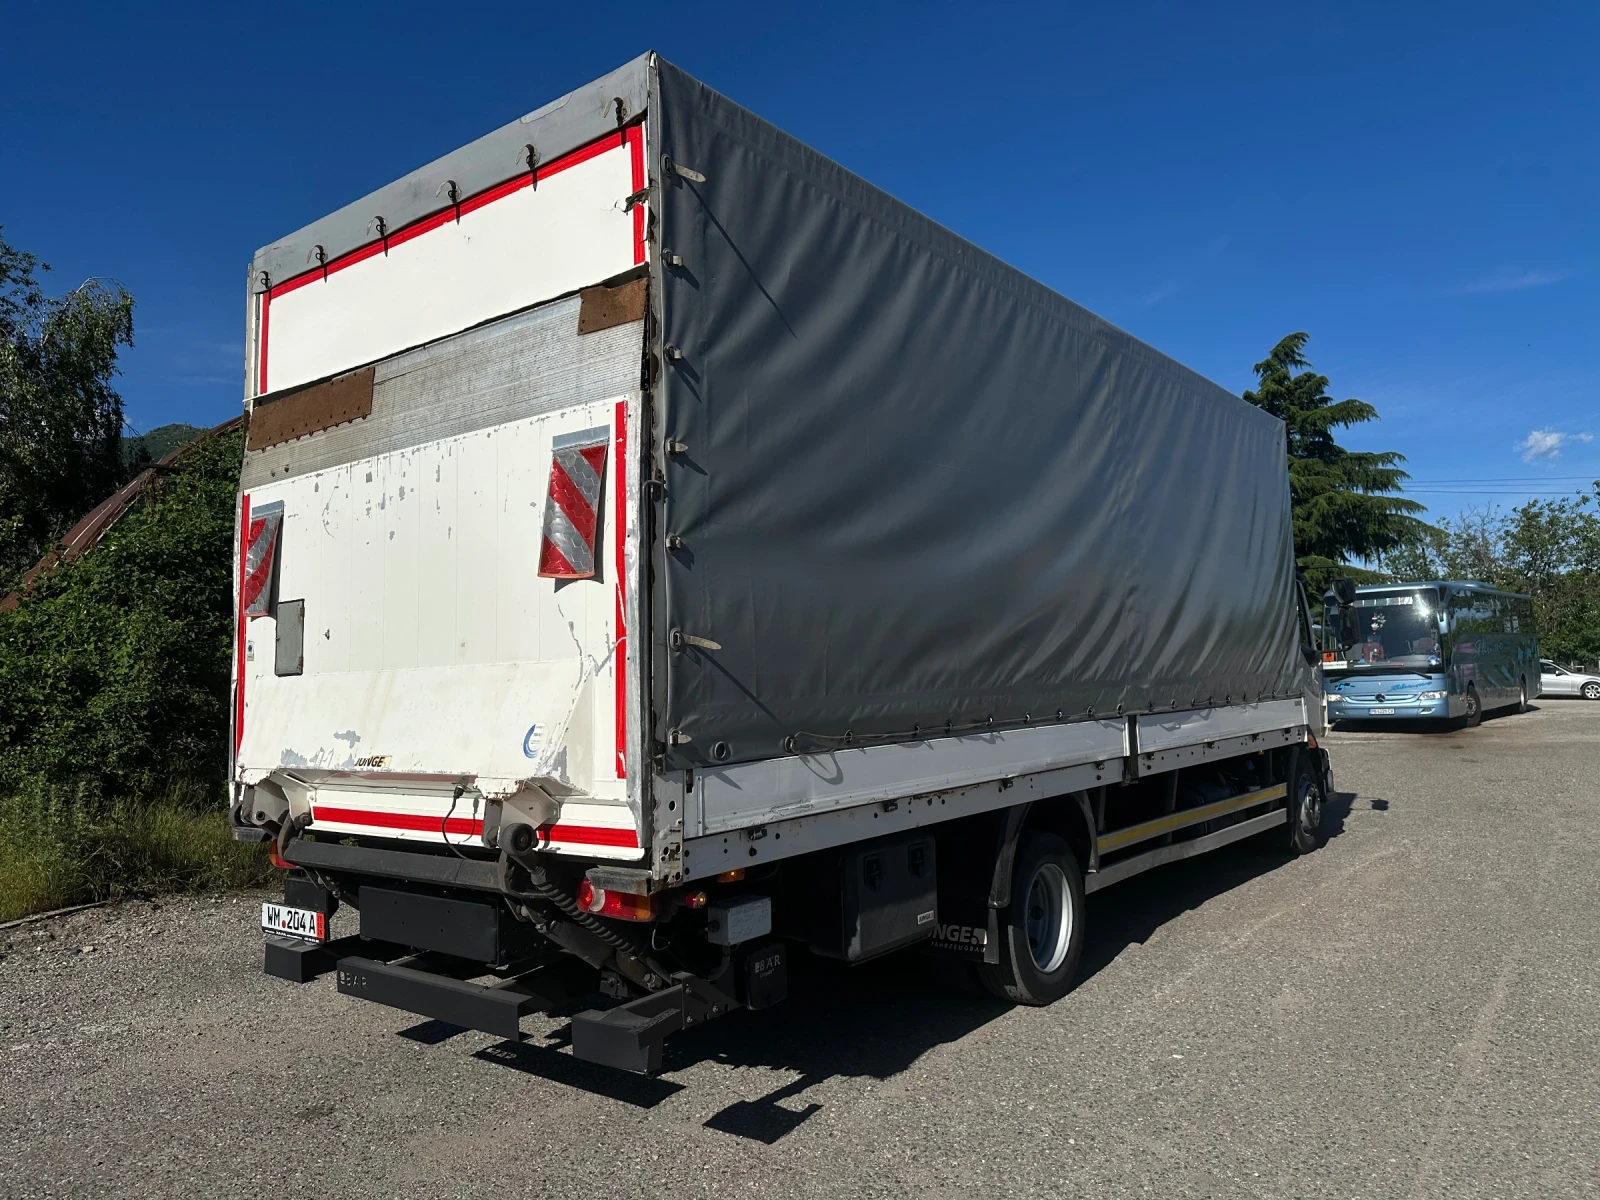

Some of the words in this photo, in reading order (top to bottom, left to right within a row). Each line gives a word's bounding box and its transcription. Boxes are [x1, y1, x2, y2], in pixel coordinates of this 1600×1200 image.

[354, 756, 386, 768] JUNGE
[267, 906, 281, 927] WM
[286, 910, 306, 932] 204
[308, 914, 316, 935] A
